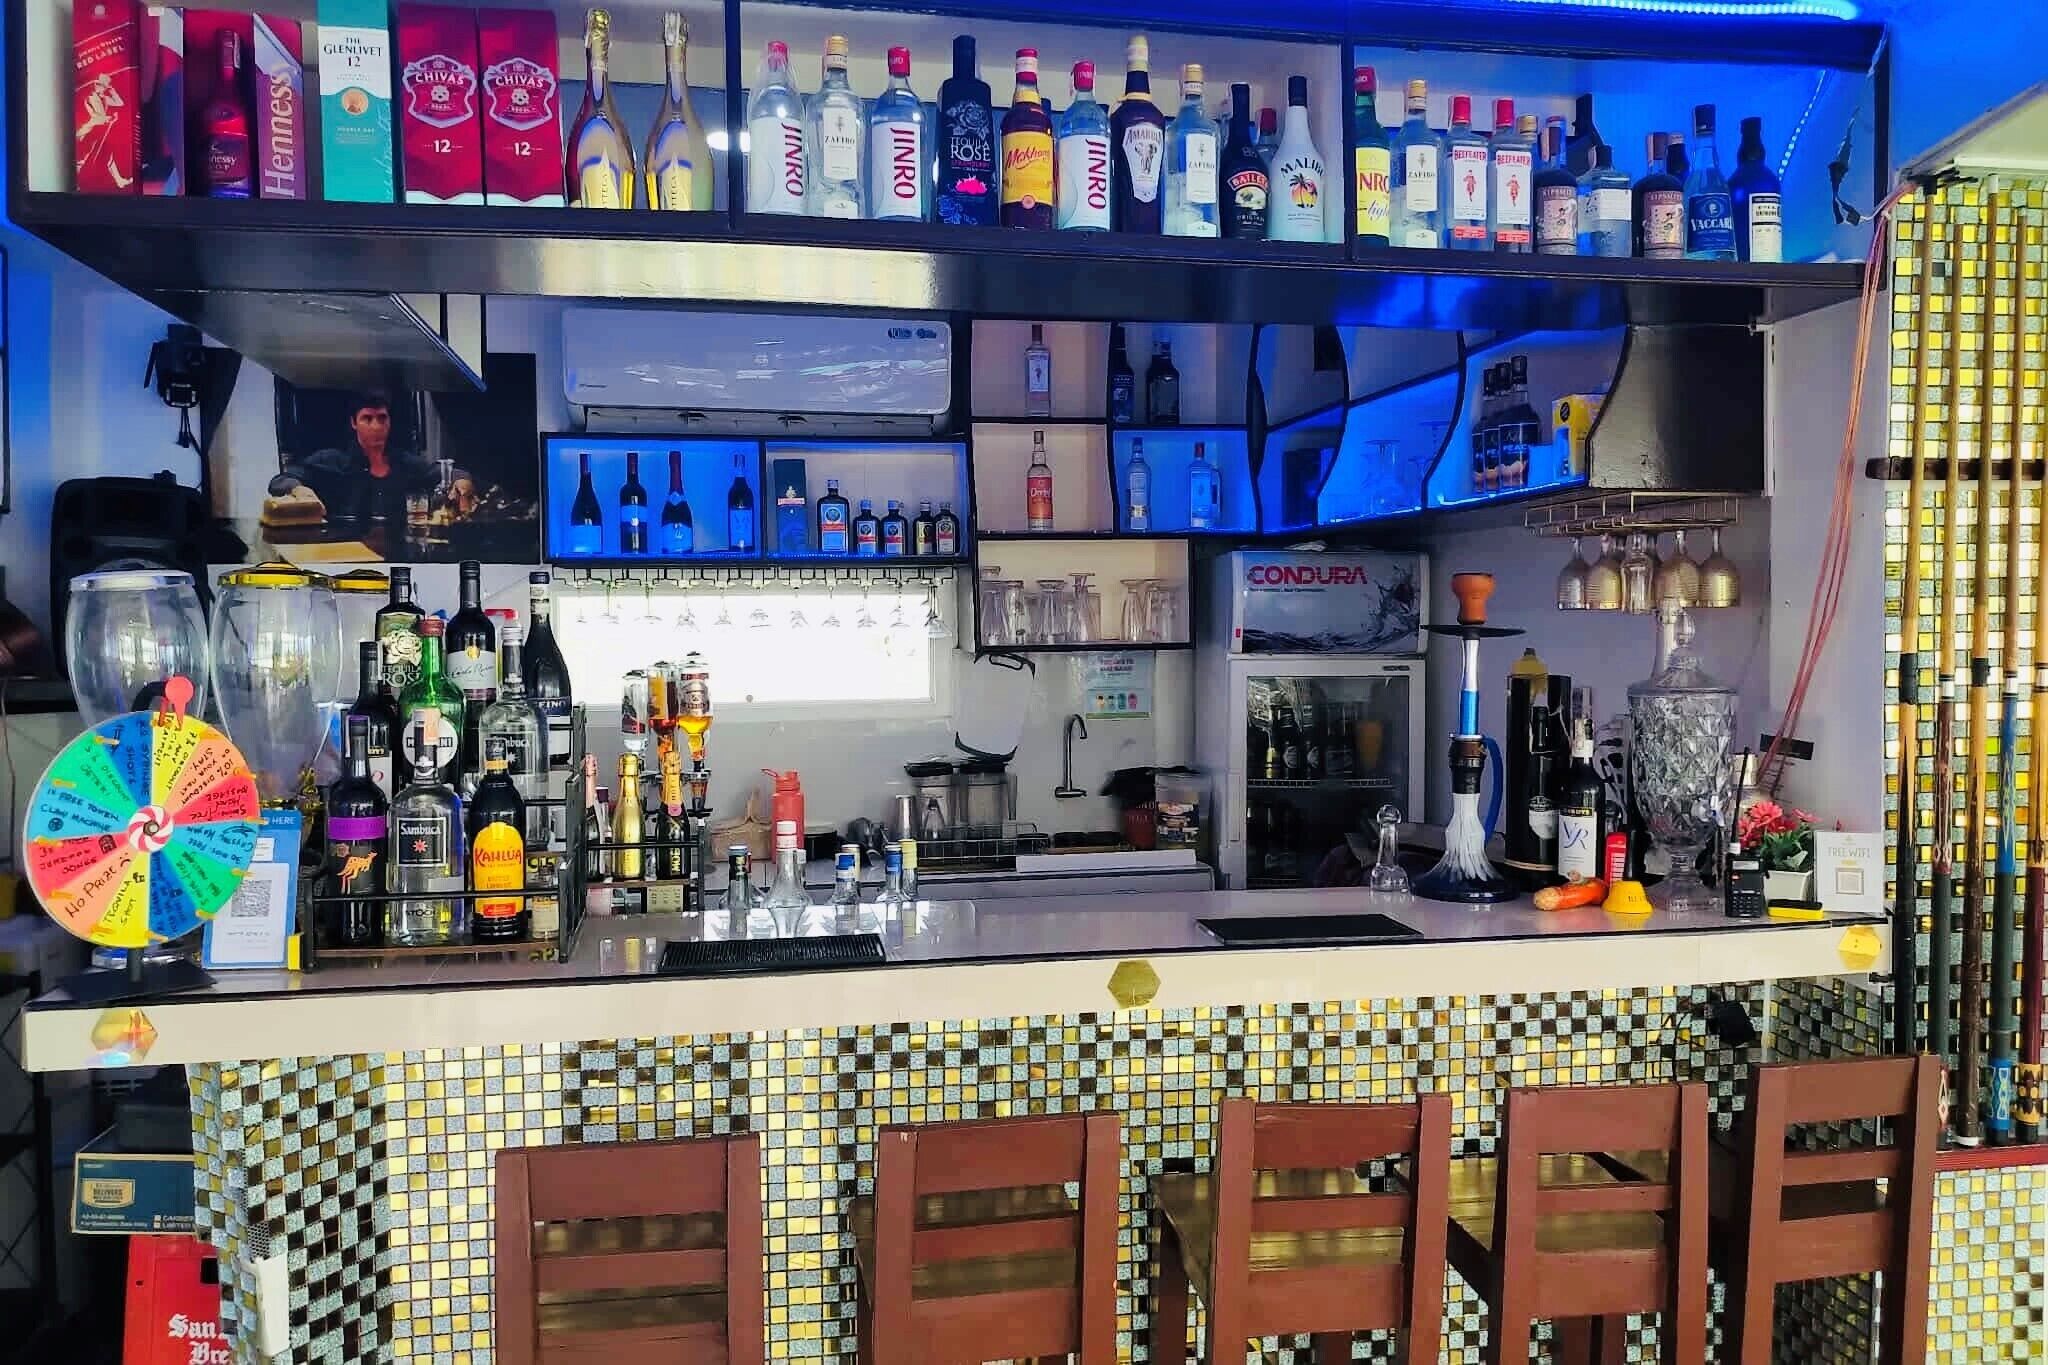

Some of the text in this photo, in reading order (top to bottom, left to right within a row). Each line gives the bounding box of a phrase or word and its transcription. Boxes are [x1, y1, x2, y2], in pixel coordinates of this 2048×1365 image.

[95, 44, 125, 60] LABEL
[323, 43, 382, 56] GLENLIVET
[348, 56, 361, 67] 12
[415, 71, 465, 85] CHIVAS
[495, 75, 544, 88] CHIVAS
[433, 139, 452, 153] 12
[824, 135, 856, 145] ZAFIRO
[951, 136, 991, 150] TEQUILA
[514, 142, 532, 156] 12
[950, 144, 992, 162] ROSE
[1454, 149, 1487, 161] BEEFEATER
[781, 122, 804, 197] JINRO
[890, 127, 917, 199] JINRO
[1497, 153, 1531, 167] BEEFEATER
[1085, 138, 1107, 210] JINRO
[1246, 565, 1368, 585] CONDURA
[382, 664, 422, 673] TEQUILA
[181, 758, 235, 806] 10% DISCOUNT
[271, 816, 296, 825] HERE
[400, 822, 441, 835] Sambuca
[167, 1313, 217, 1339] San
[188, 1340, 231, 1365] Bre
